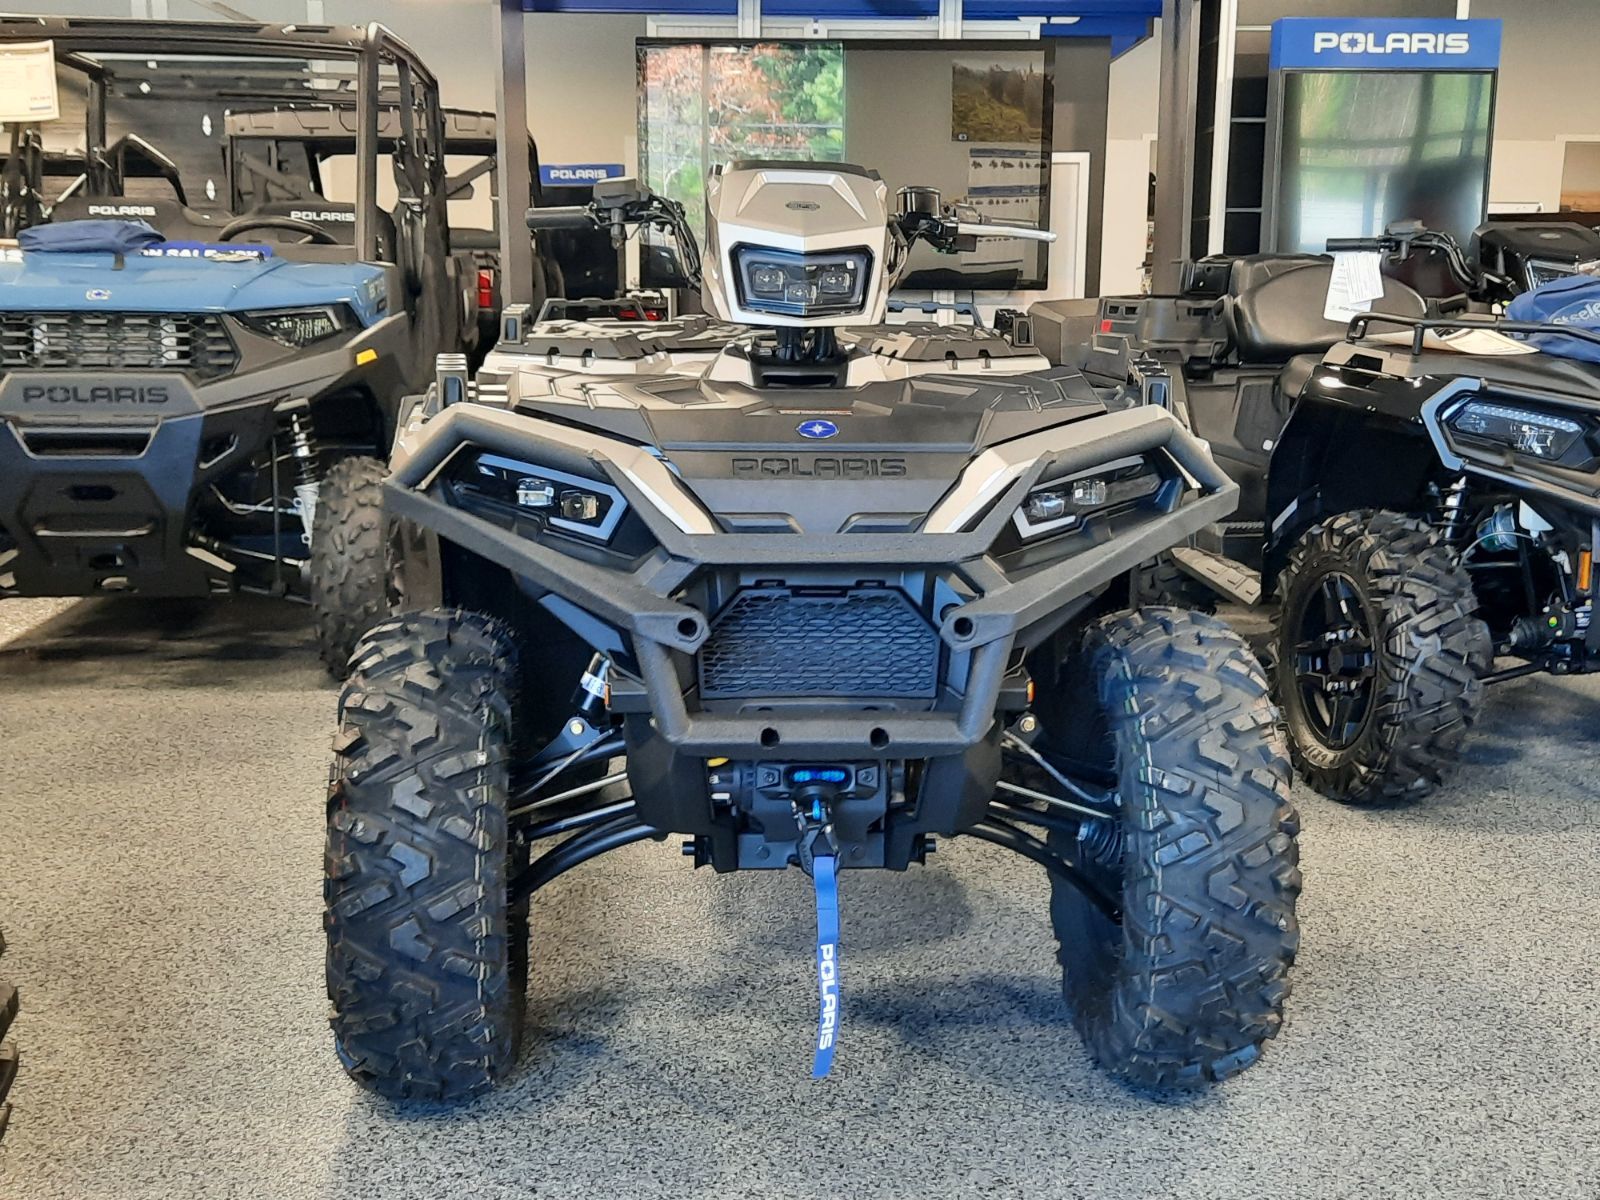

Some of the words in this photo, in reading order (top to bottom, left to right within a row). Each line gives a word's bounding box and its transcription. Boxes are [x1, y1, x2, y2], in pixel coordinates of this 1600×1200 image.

[1313, 32, 1470, 54] POLARIS
[550, 169, 607, 180] POLARIS
[88, 205, 156, 216] POLARIS
[290, 211, 356, 222] POLARIS
[22, 386, 169, 403] POLARIS
[732, 458, 907, 476] POLARIS
[819, 943, 837, 1050] POLARIS
